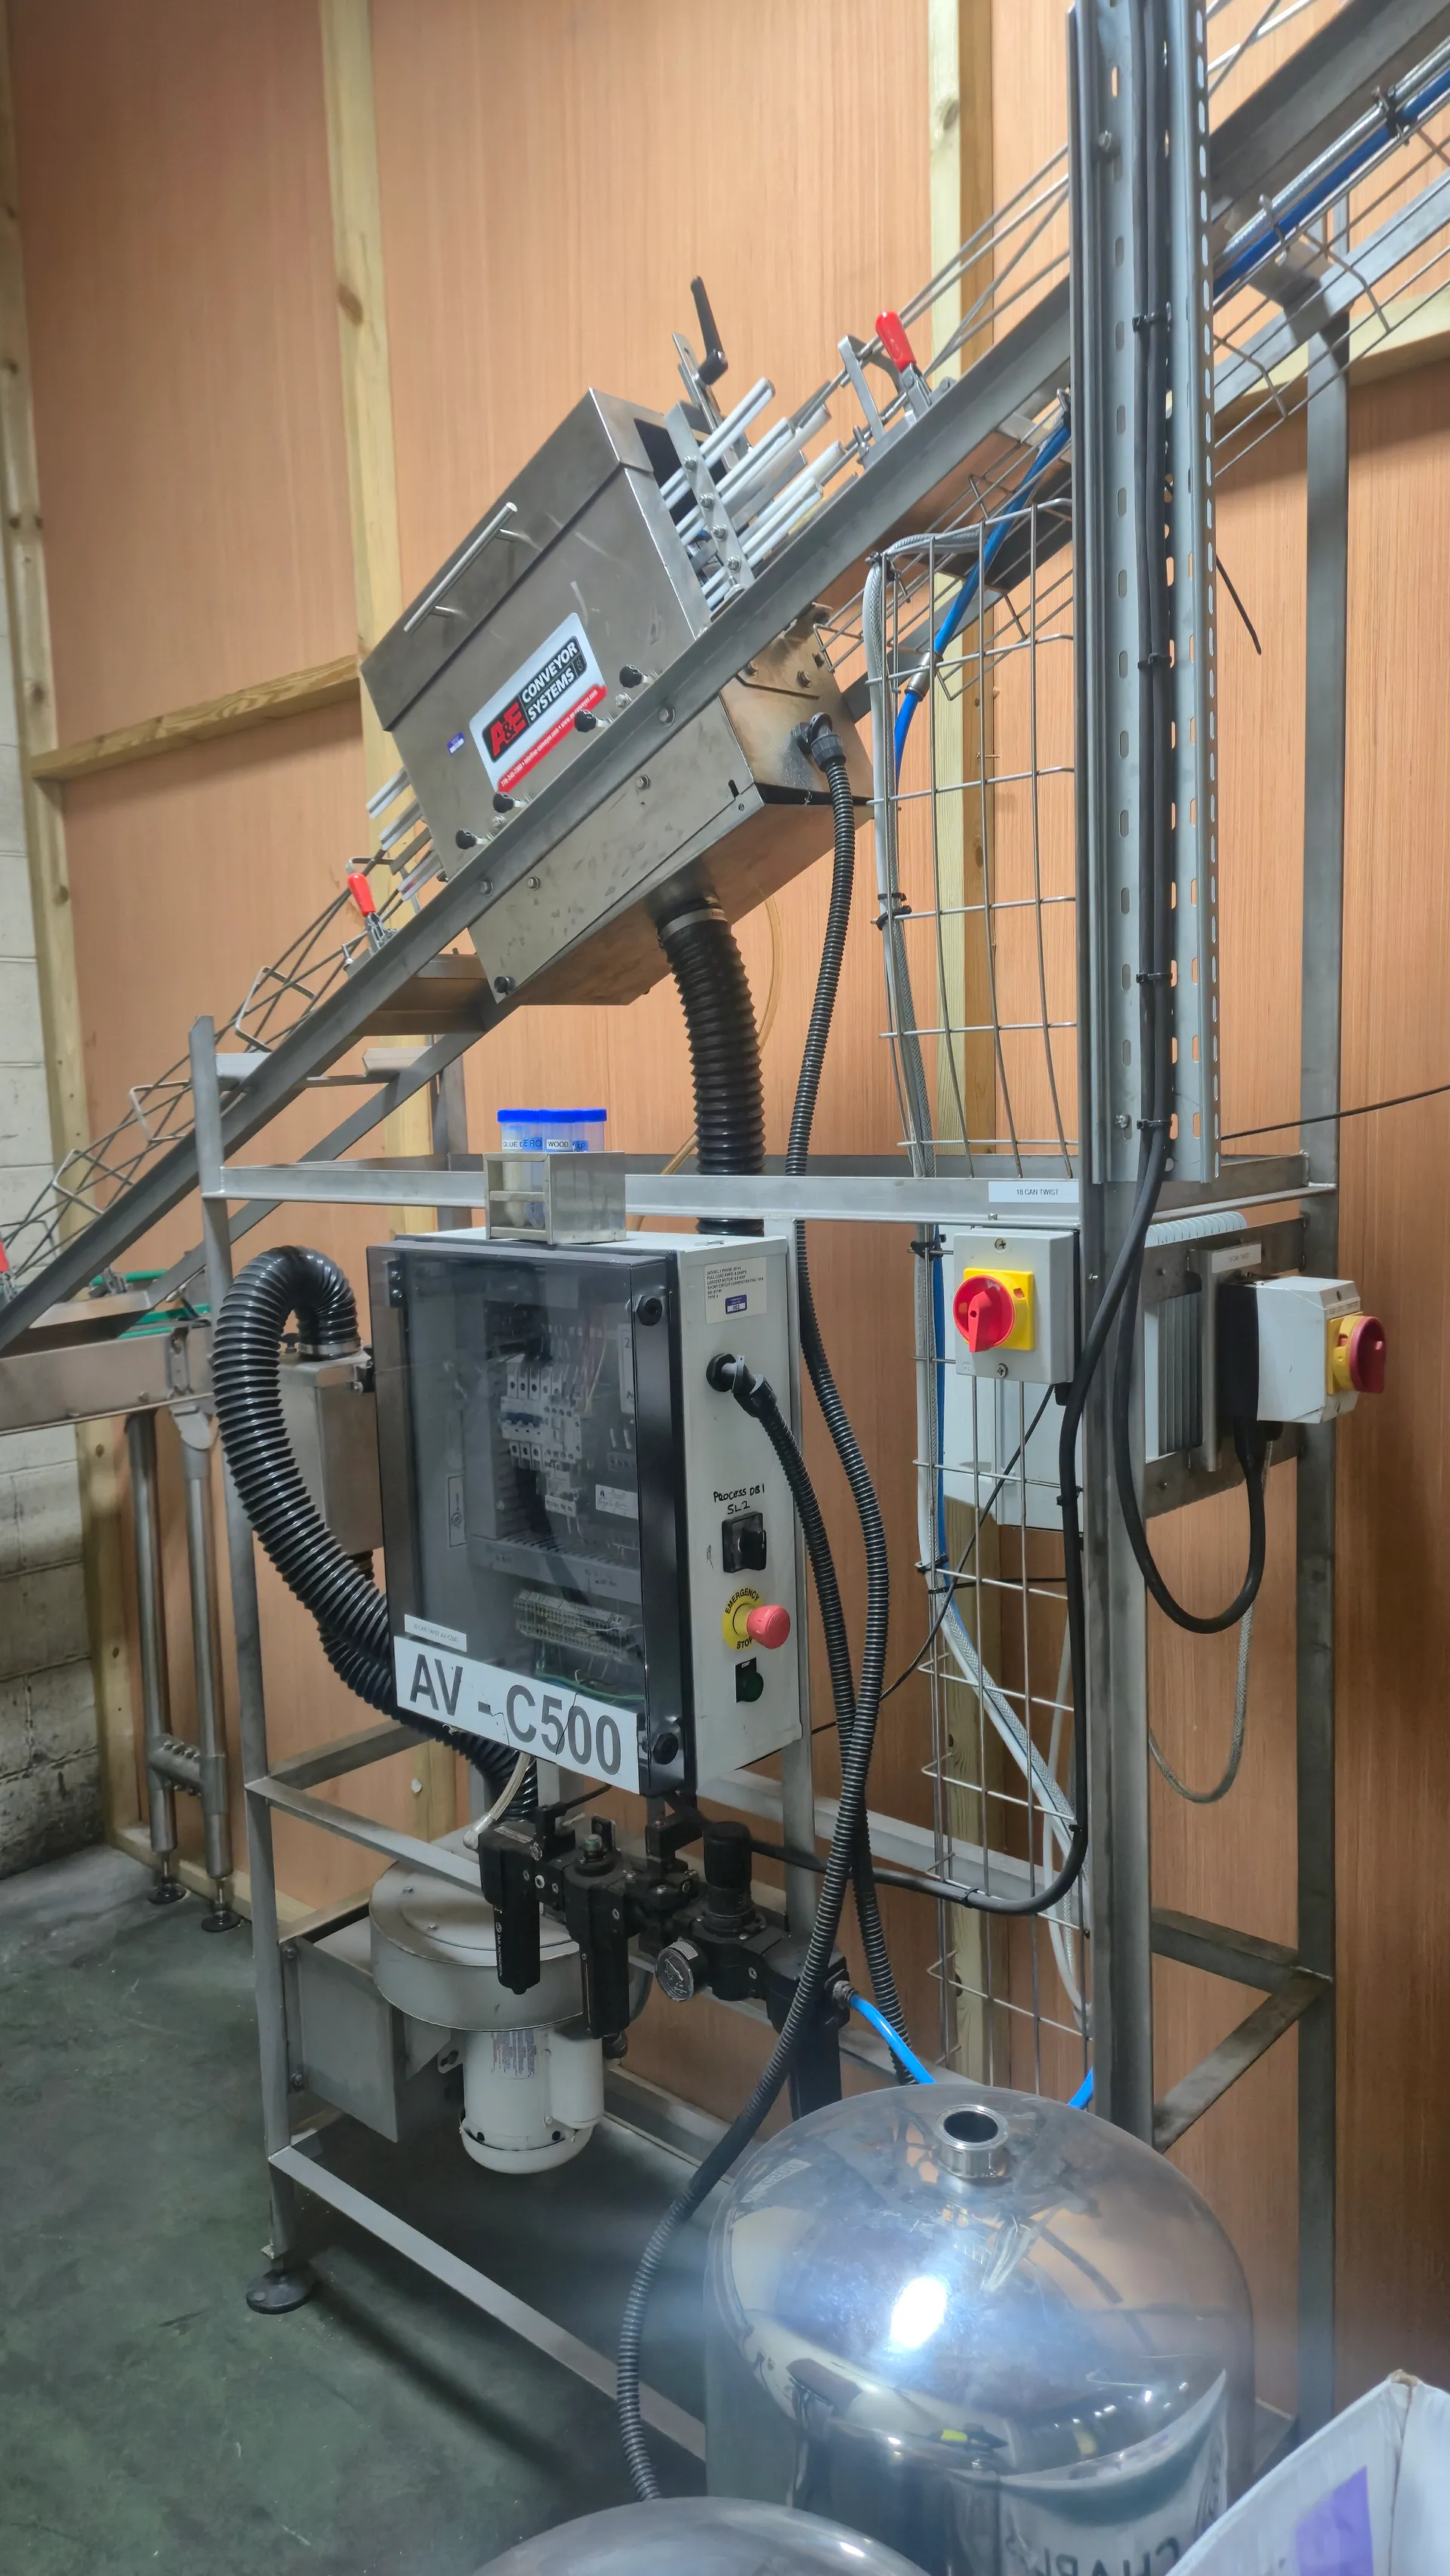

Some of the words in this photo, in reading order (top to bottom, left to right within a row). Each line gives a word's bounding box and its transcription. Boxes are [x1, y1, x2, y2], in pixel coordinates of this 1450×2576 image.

[521, 642, 578, 703] CONVEYOR
[527, 667, 575, 722] SYSTEMS
[490, 702, 527, 756] A&E
[713, 1488, 747, 1503] PROCESS
[725, 1588, 760, 1614] EMERGENCY
[409, 1653, 463, 1717] AV
[506, 1684, 622, 1776] C500
